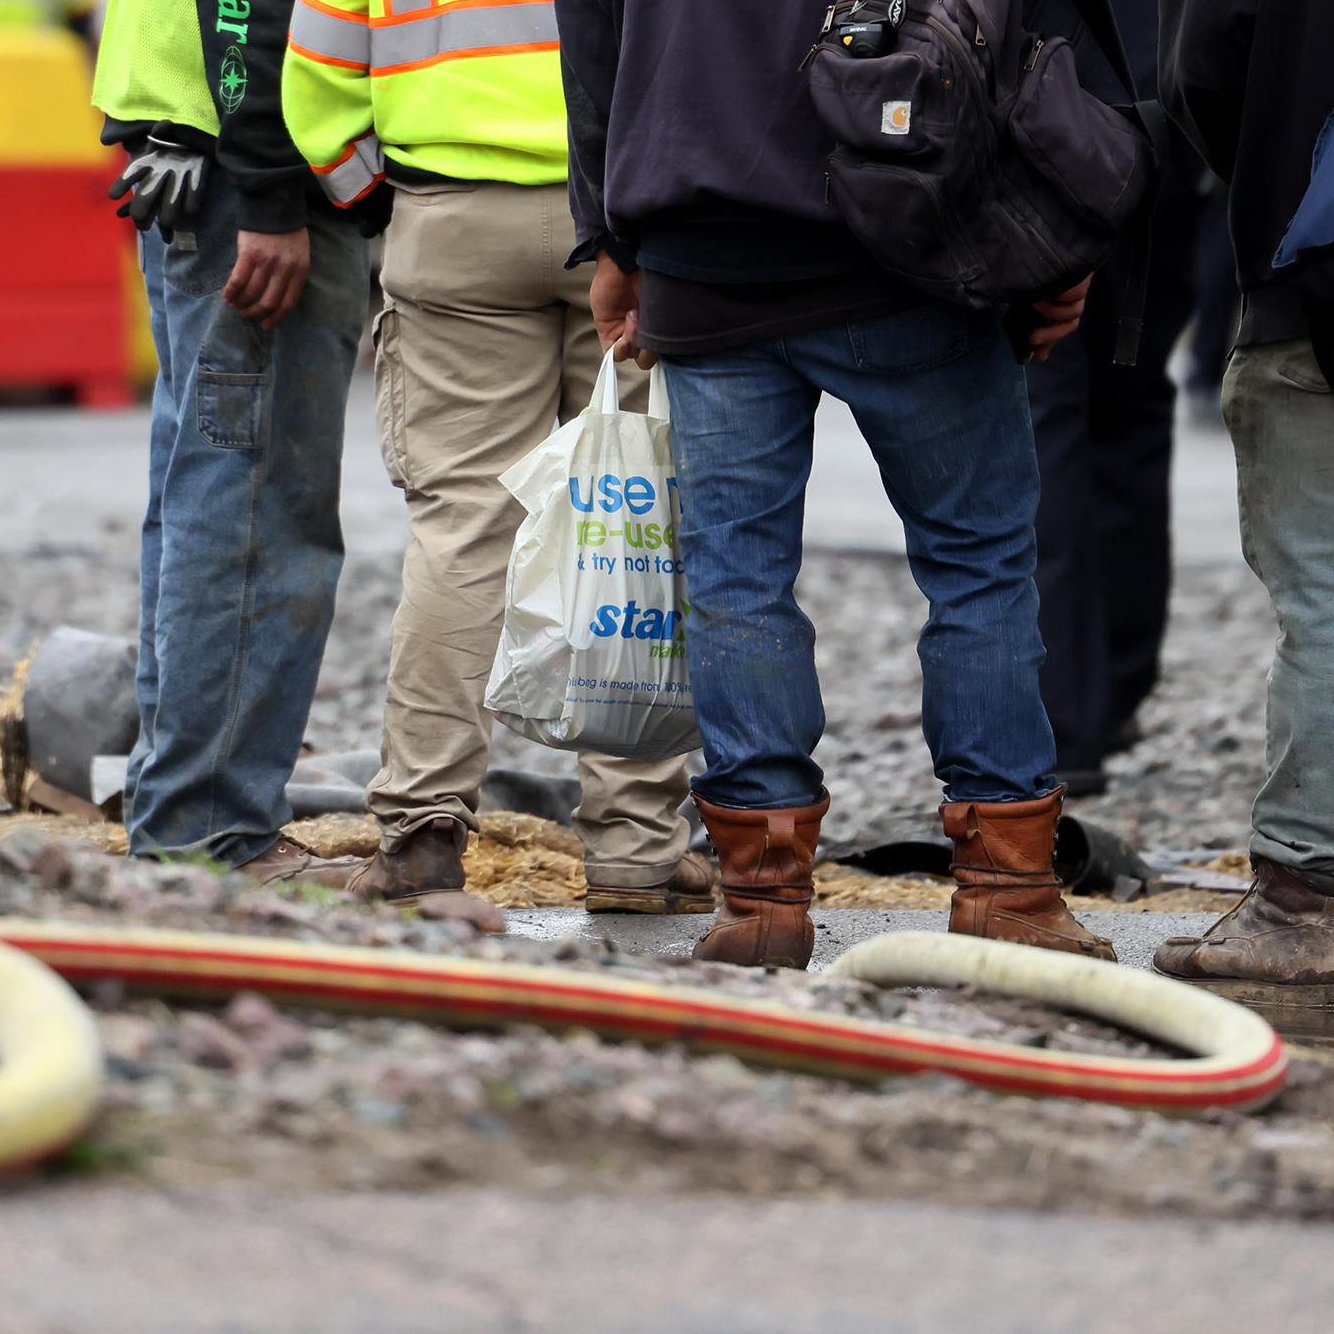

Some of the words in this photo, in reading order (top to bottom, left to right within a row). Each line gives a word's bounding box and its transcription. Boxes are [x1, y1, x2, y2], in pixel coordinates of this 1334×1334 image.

[569, 474, 656, 515] use
[592, 552, 617, 575] try
[624, 556, 650, 573] not
[589, 599, 683, 641] star
[578, 676, 597, 690] bag
[599, 677, 608, 689] is
[610, 680, 639, 692] made
